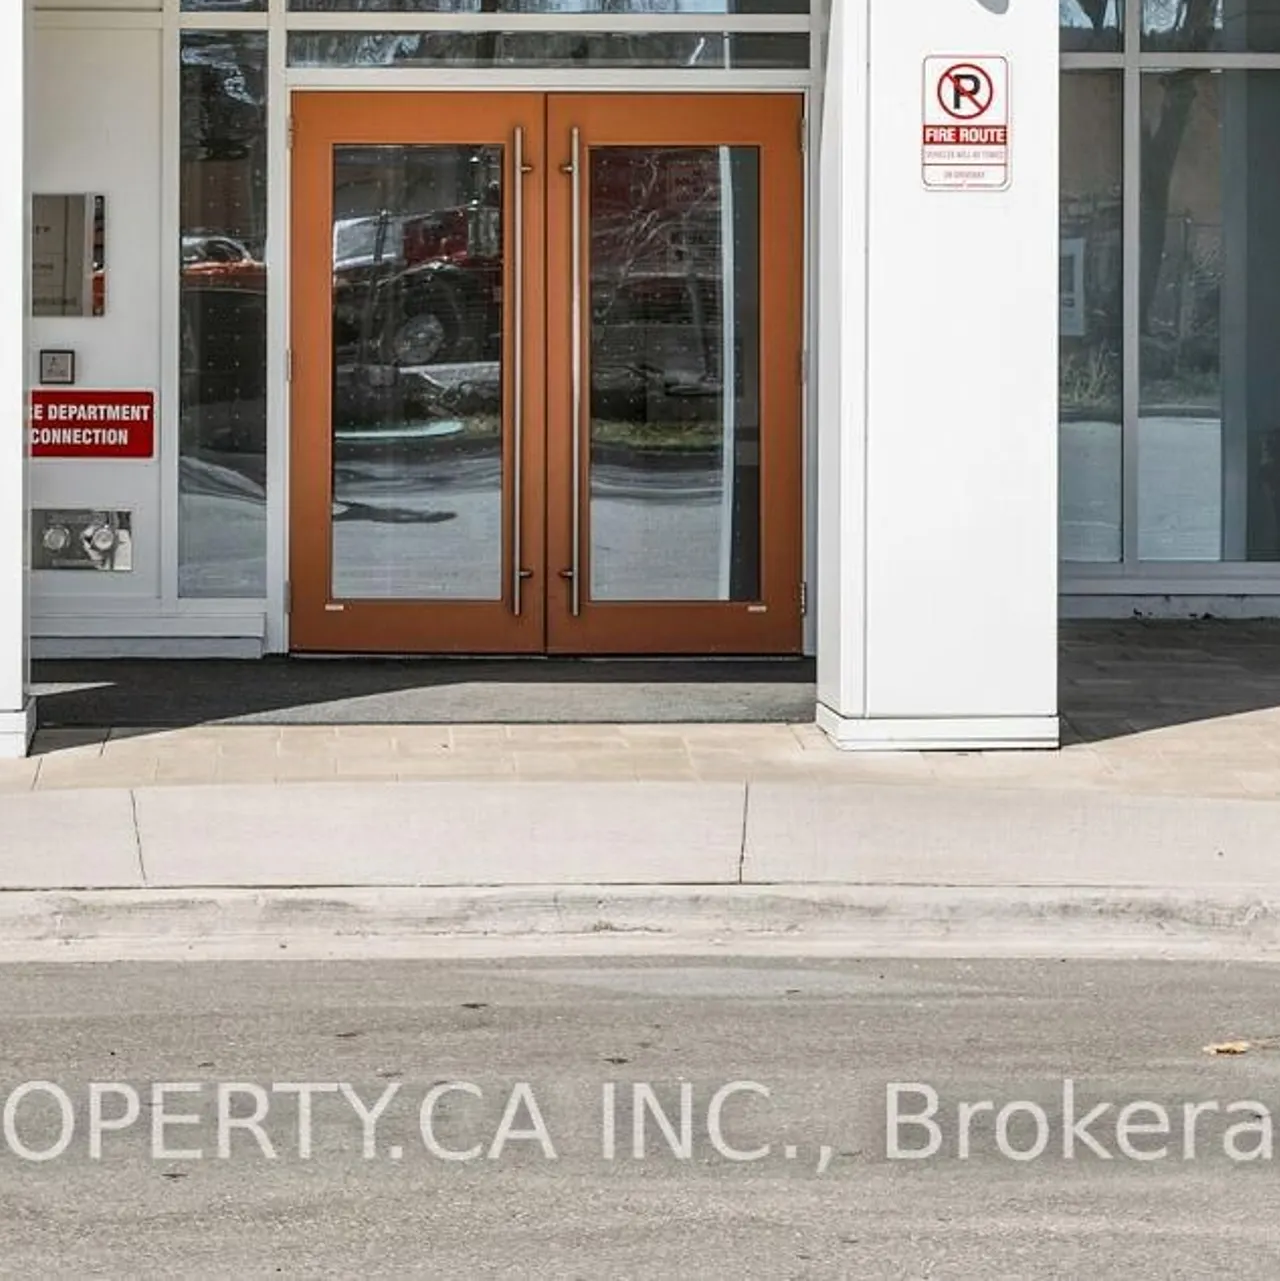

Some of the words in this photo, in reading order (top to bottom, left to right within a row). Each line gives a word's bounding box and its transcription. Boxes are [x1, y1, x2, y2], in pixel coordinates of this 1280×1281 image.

[925, 126, 957, 142] FIRE
[960, 126, 1005, 142] ROUTE
[47, 403, 151, 421] DEPARTMENT
[30, 427, 129, 446] CONNECTION
